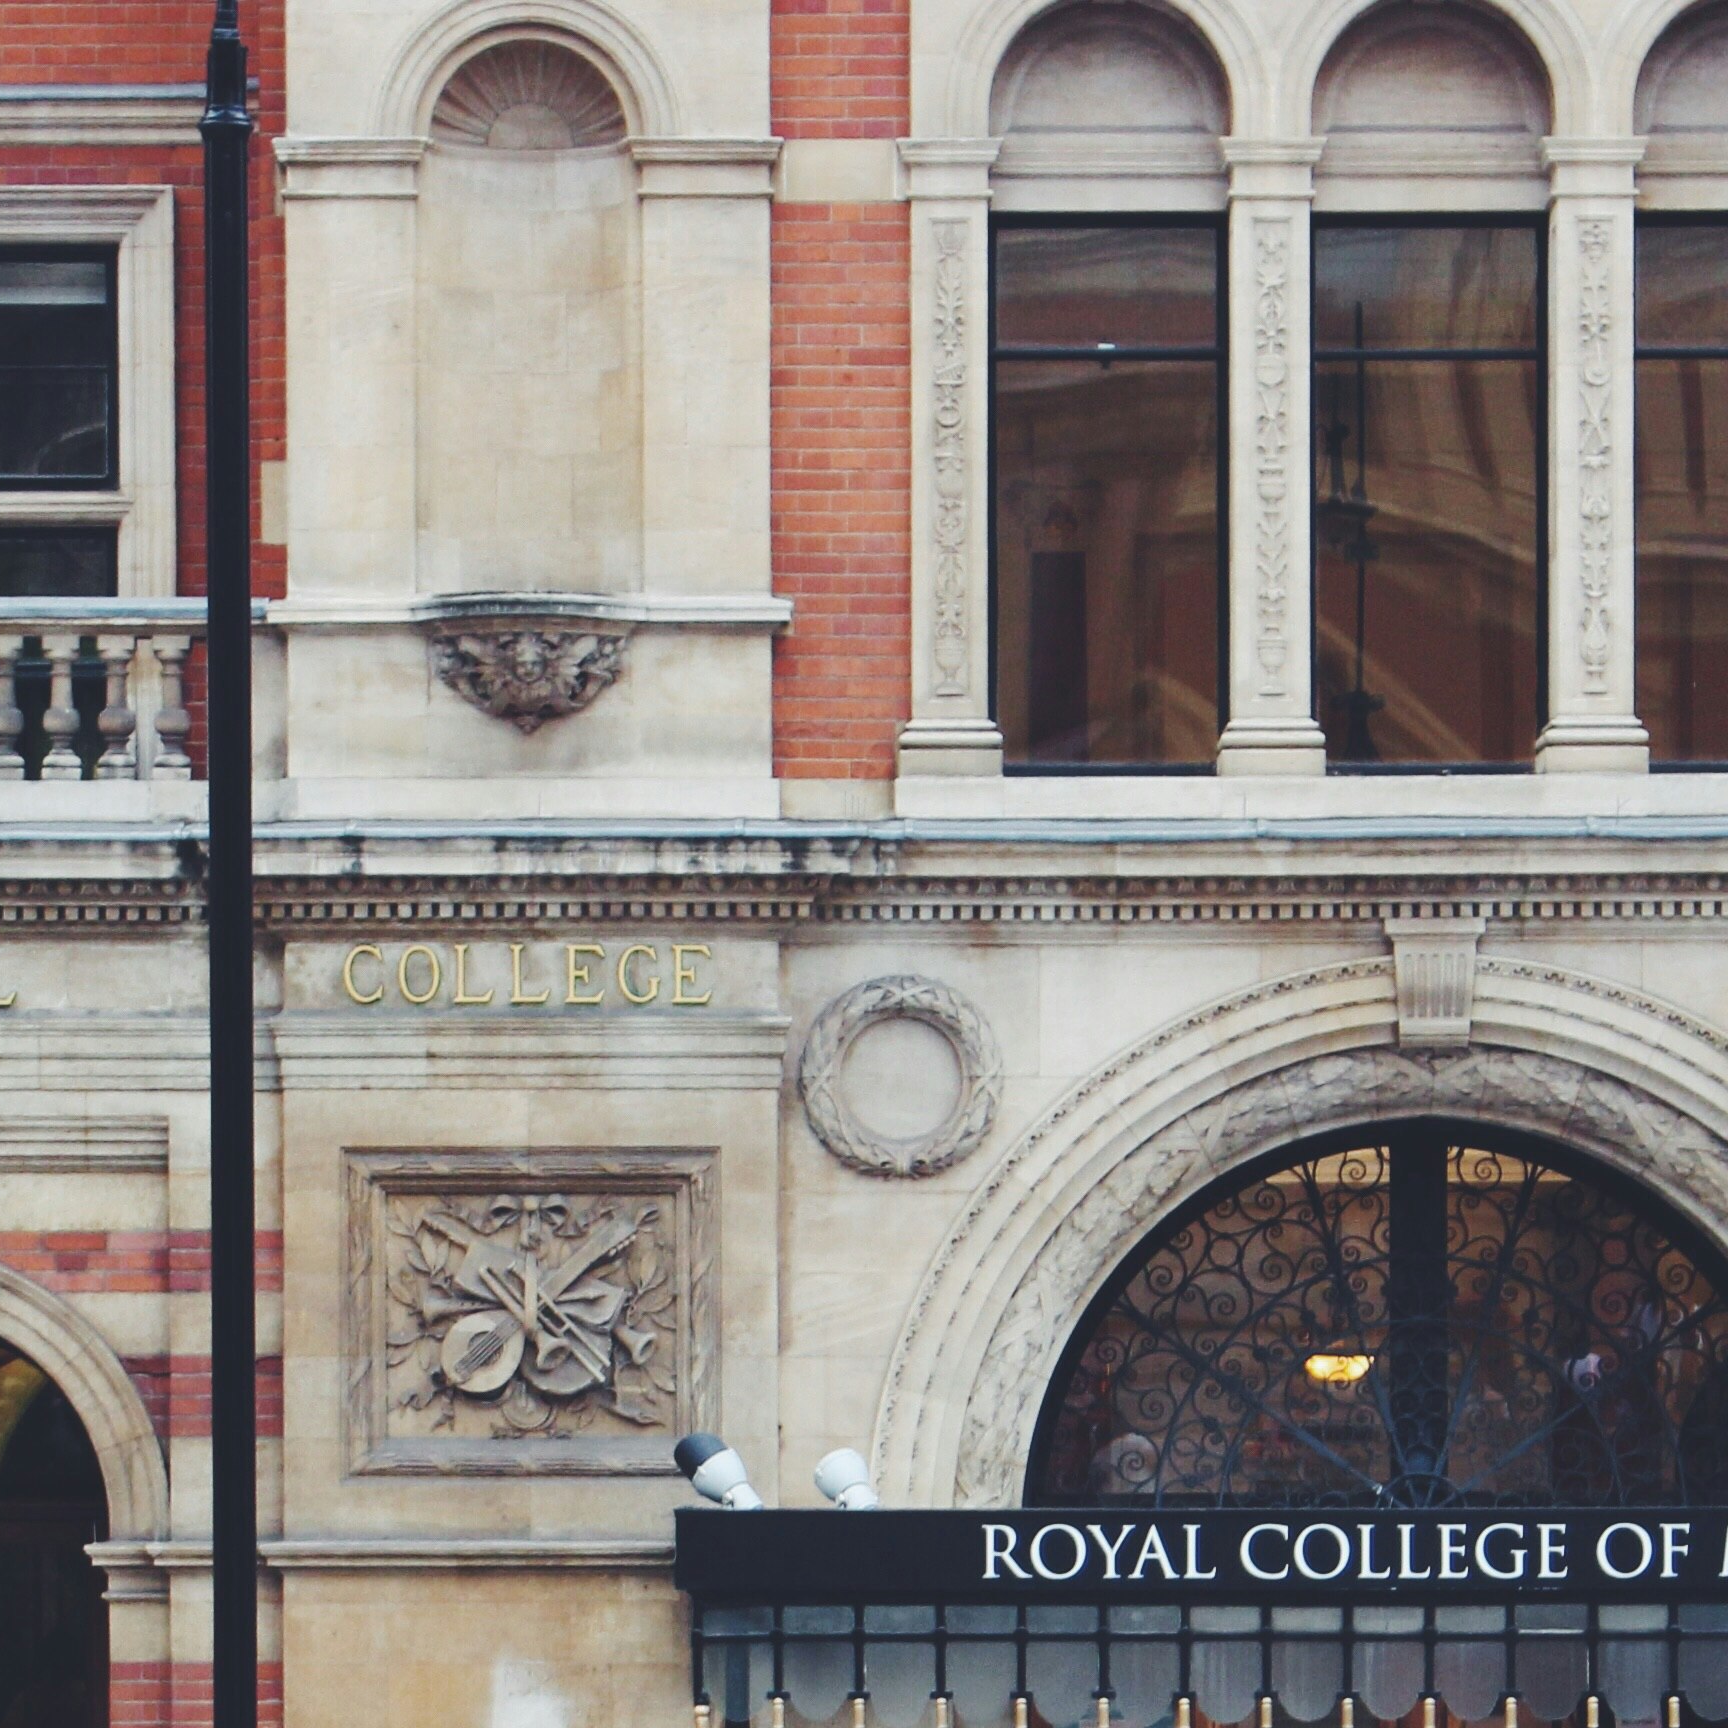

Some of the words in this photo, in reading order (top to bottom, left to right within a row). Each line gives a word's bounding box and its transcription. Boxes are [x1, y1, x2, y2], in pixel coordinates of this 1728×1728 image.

[343, 941, 716, 1007] COLLEGE
[980, 1523, 1217, 1582] ROYAL
[1239, 1522, 1570, 1581] COLLEGE
[1595, 1522, 1691, 1579] OF
